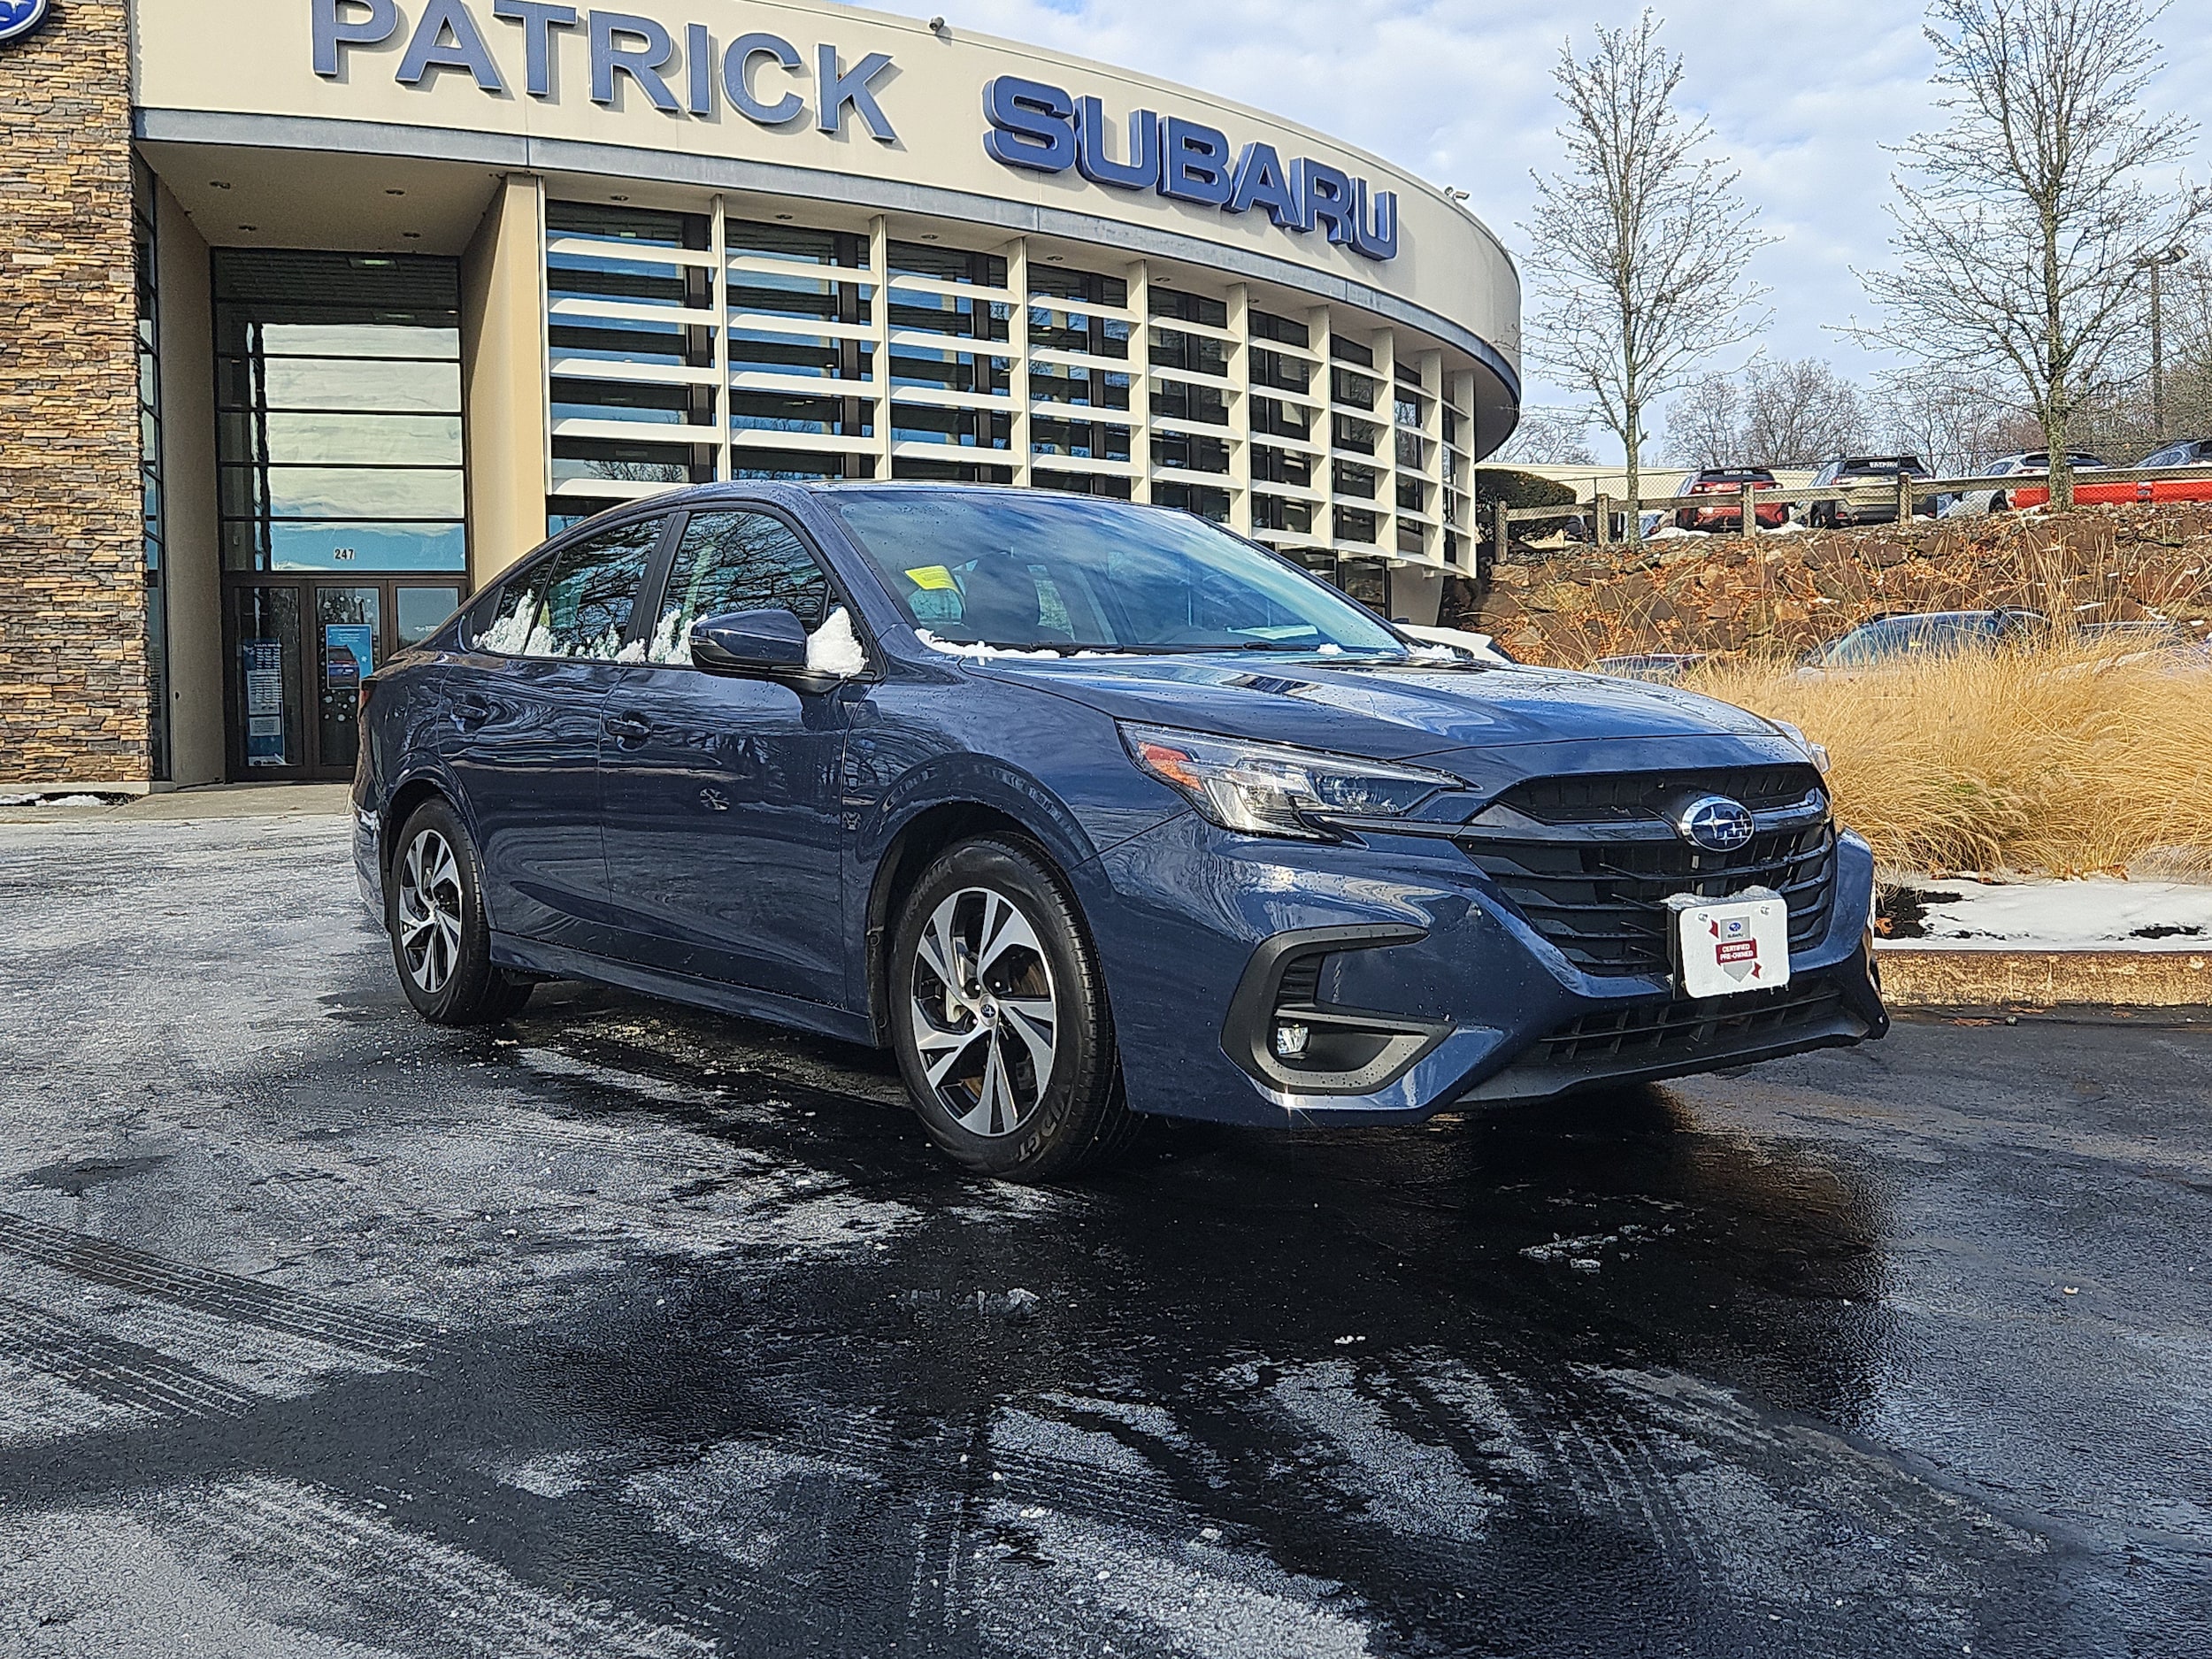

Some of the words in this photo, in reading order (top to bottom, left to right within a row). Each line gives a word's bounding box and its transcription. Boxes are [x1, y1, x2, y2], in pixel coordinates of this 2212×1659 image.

[311, 0, 896, 143] PATRICK
[982, 74, 1399, 261] SUBARU
[334, 549, 354, 560] 247
[1722, 944, 1750, 953] CERTIFIED
[1720, 951, 1753, 960] PRE-OWNED
